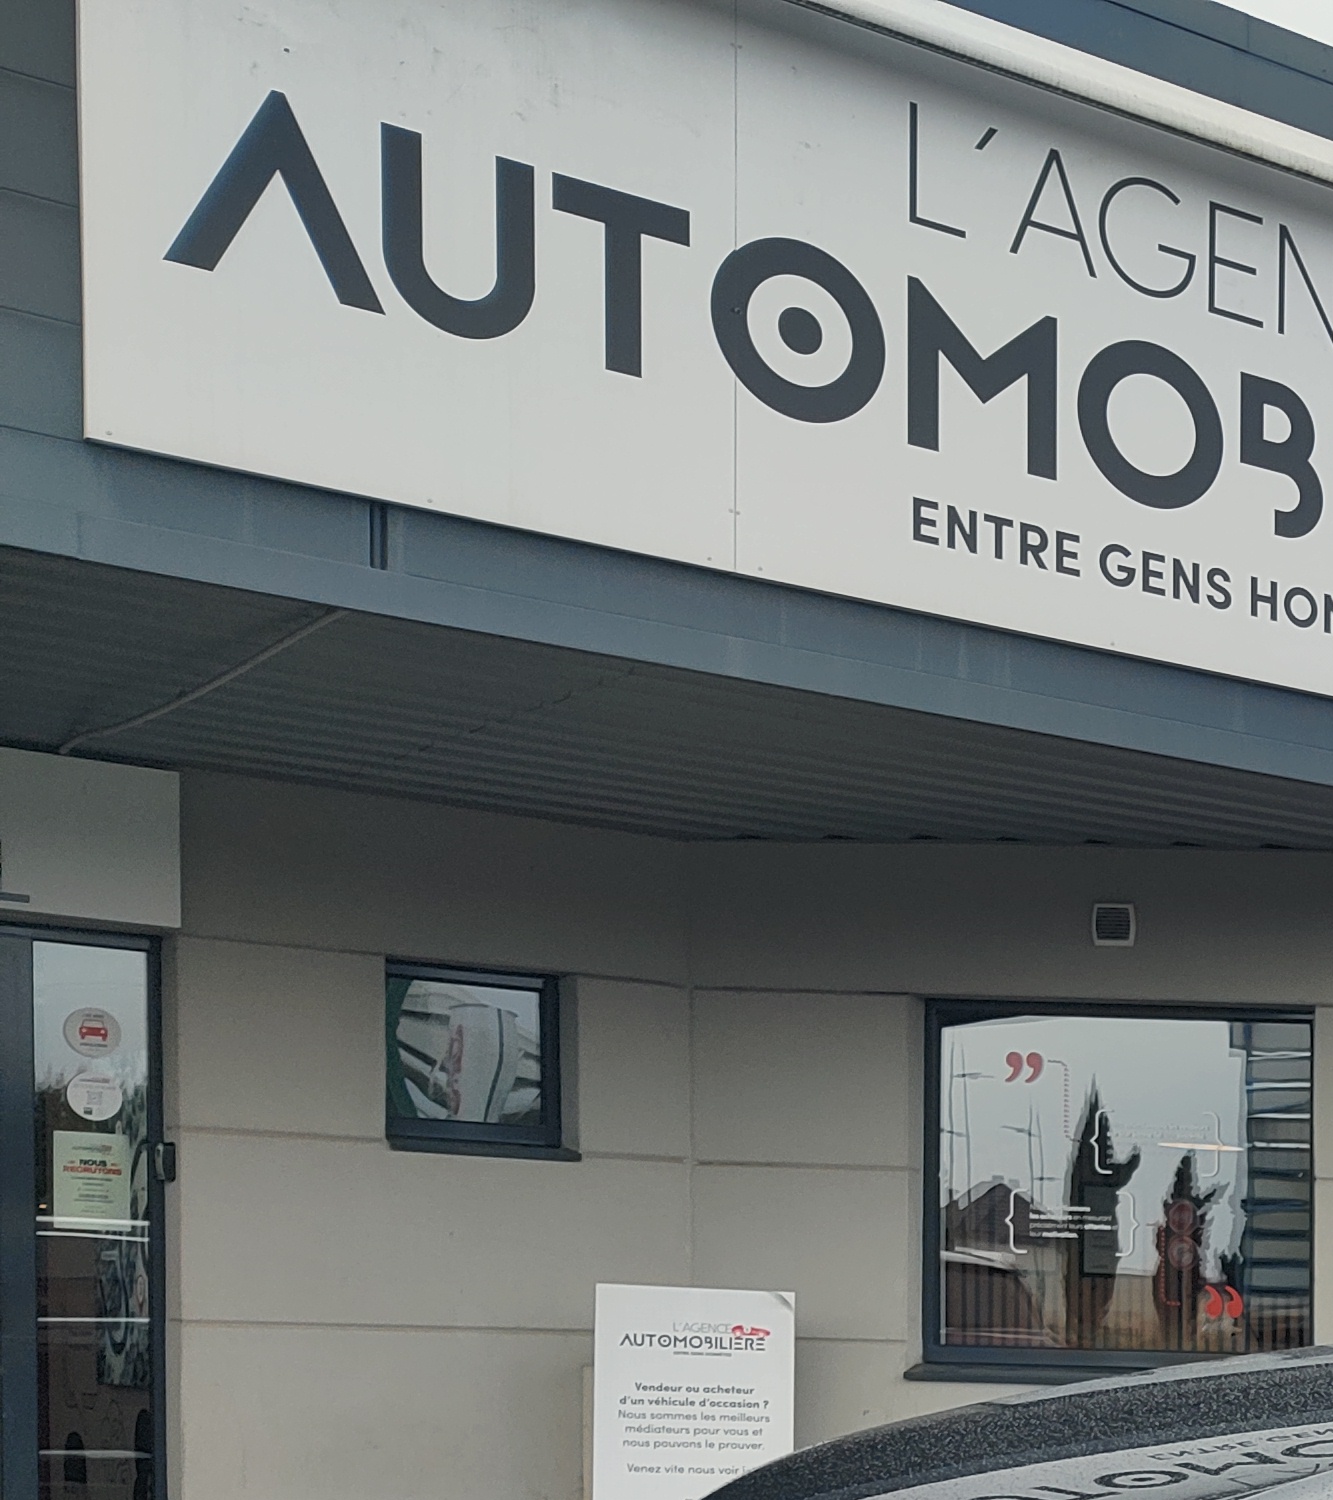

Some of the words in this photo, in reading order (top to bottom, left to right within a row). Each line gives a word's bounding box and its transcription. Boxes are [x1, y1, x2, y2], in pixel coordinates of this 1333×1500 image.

[911, 496, 1082, 579] ENTRE
[1098, 543, 1233, 611] GENS
[79, 1158, 107, 1167] NOUS
[634, 1381, 683, 1393] Vendeur
[686, 1386, 700, 1394] ou
[703, 1385, 755, 1396] acheteur
[619, 1396, 645, 1406] d'un
[648, 1396, 696, 1407] véhicule
[699, 1398, 760, 1409] d'occasion
[763, 1400, 769, 1409] ?
[618, 1409, 647, 1420] Nous
[650, 1412, 698, 1421] sommes
[701, 1412, 717, 1422] les
[719, 1413, 771, 1424] meilleurs
[624, 1424, 691, 1435] médiateurs
[693, 1427, 721, 1438] pour
[723, 1429, 749, 1437] vous
[752, 1428, 763, 1437] et
[622, 1440, 650, 1448] nous
[653, 1441, 702, 1450] pouvons
[705, 1439, 715, 1449] le
[718, 1442, 765, 1451] prouver.
[626, 1462, 662, 1474] Venez
[664, 1465, 685, 1474] vite
[688, 1466, 715, 1475] nous
[718, 1466, 740, 1475] voir
